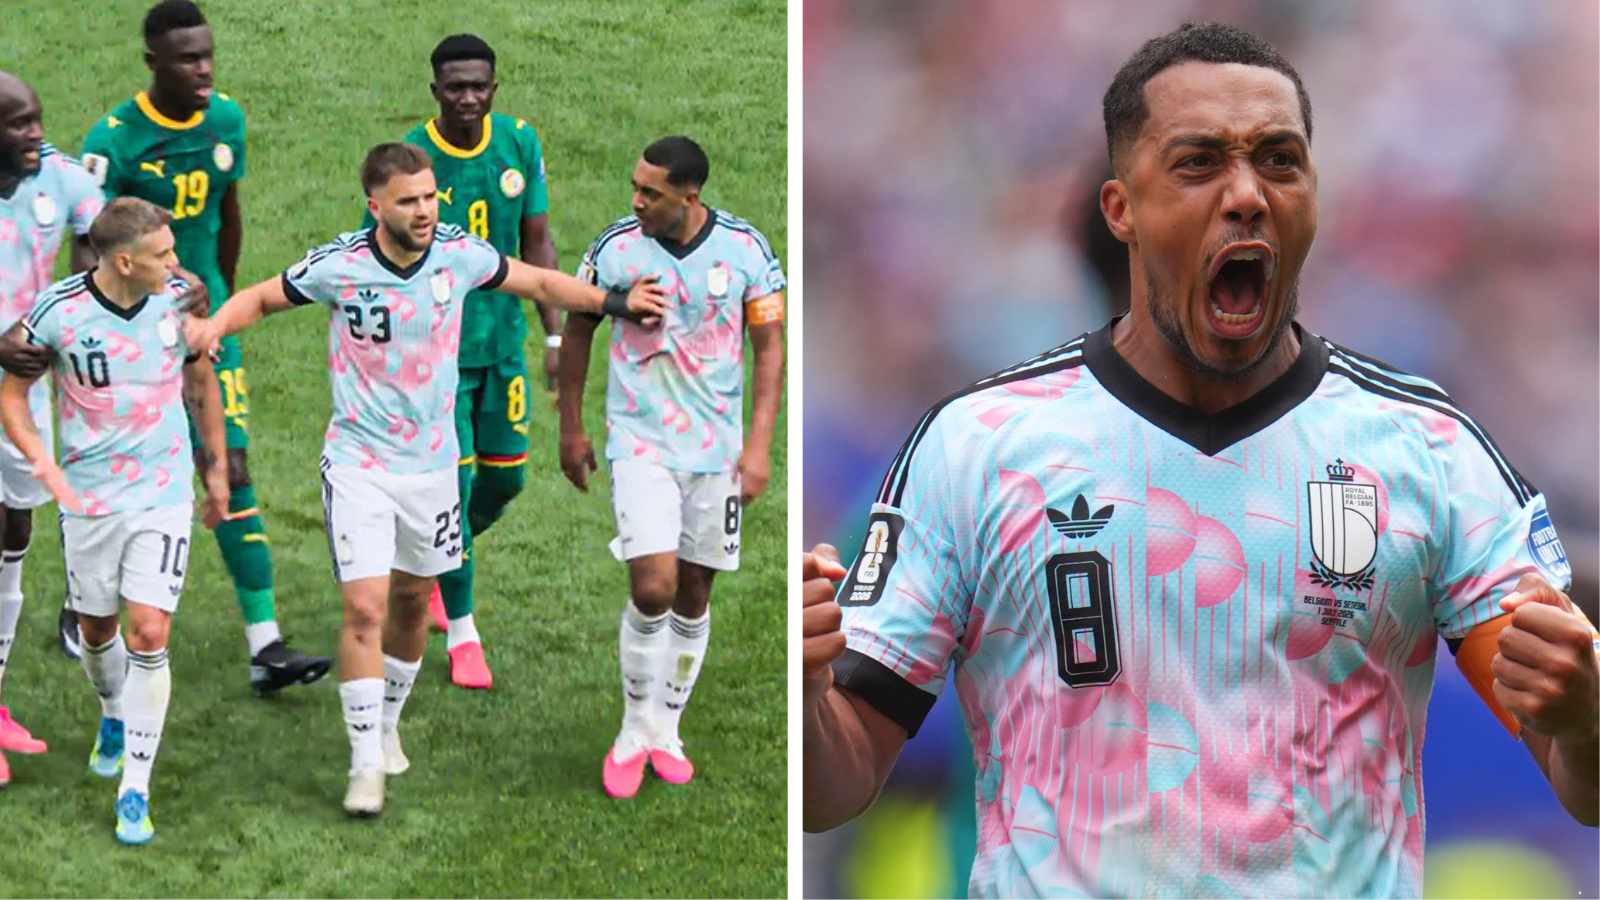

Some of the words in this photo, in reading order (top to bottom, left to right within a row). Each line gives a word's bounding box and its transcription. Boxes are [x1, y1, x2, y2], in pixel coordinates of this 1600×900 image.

[172, 170, 209, 219] 19
[468, 200, 489, 241] 8
[344, 305, 391, 343] 23
[69, 351, 111, 388] 10
[507, 375, 526, 422] 8
[724, 495, 739, 535] 8
[1531, 524, 1558, 547] FOOTB
[1536, 538, 1567, 565] UNIT
[849, 591, 872, 601] 2026
[1303, 595, 1333, 606] BELGIUM
[1333, 599, 1342, 608] VS
[1343, 600, 1367, 611] SENEGAL
[1317, 606, 1321, 615] 1
[1322, 607, 1337, 617] JULY
[1338, 609, 1354, 619] 2026
[1045, 550, 1123, 689] 8
[1321, 616, 1347, 627] SEATTLE
